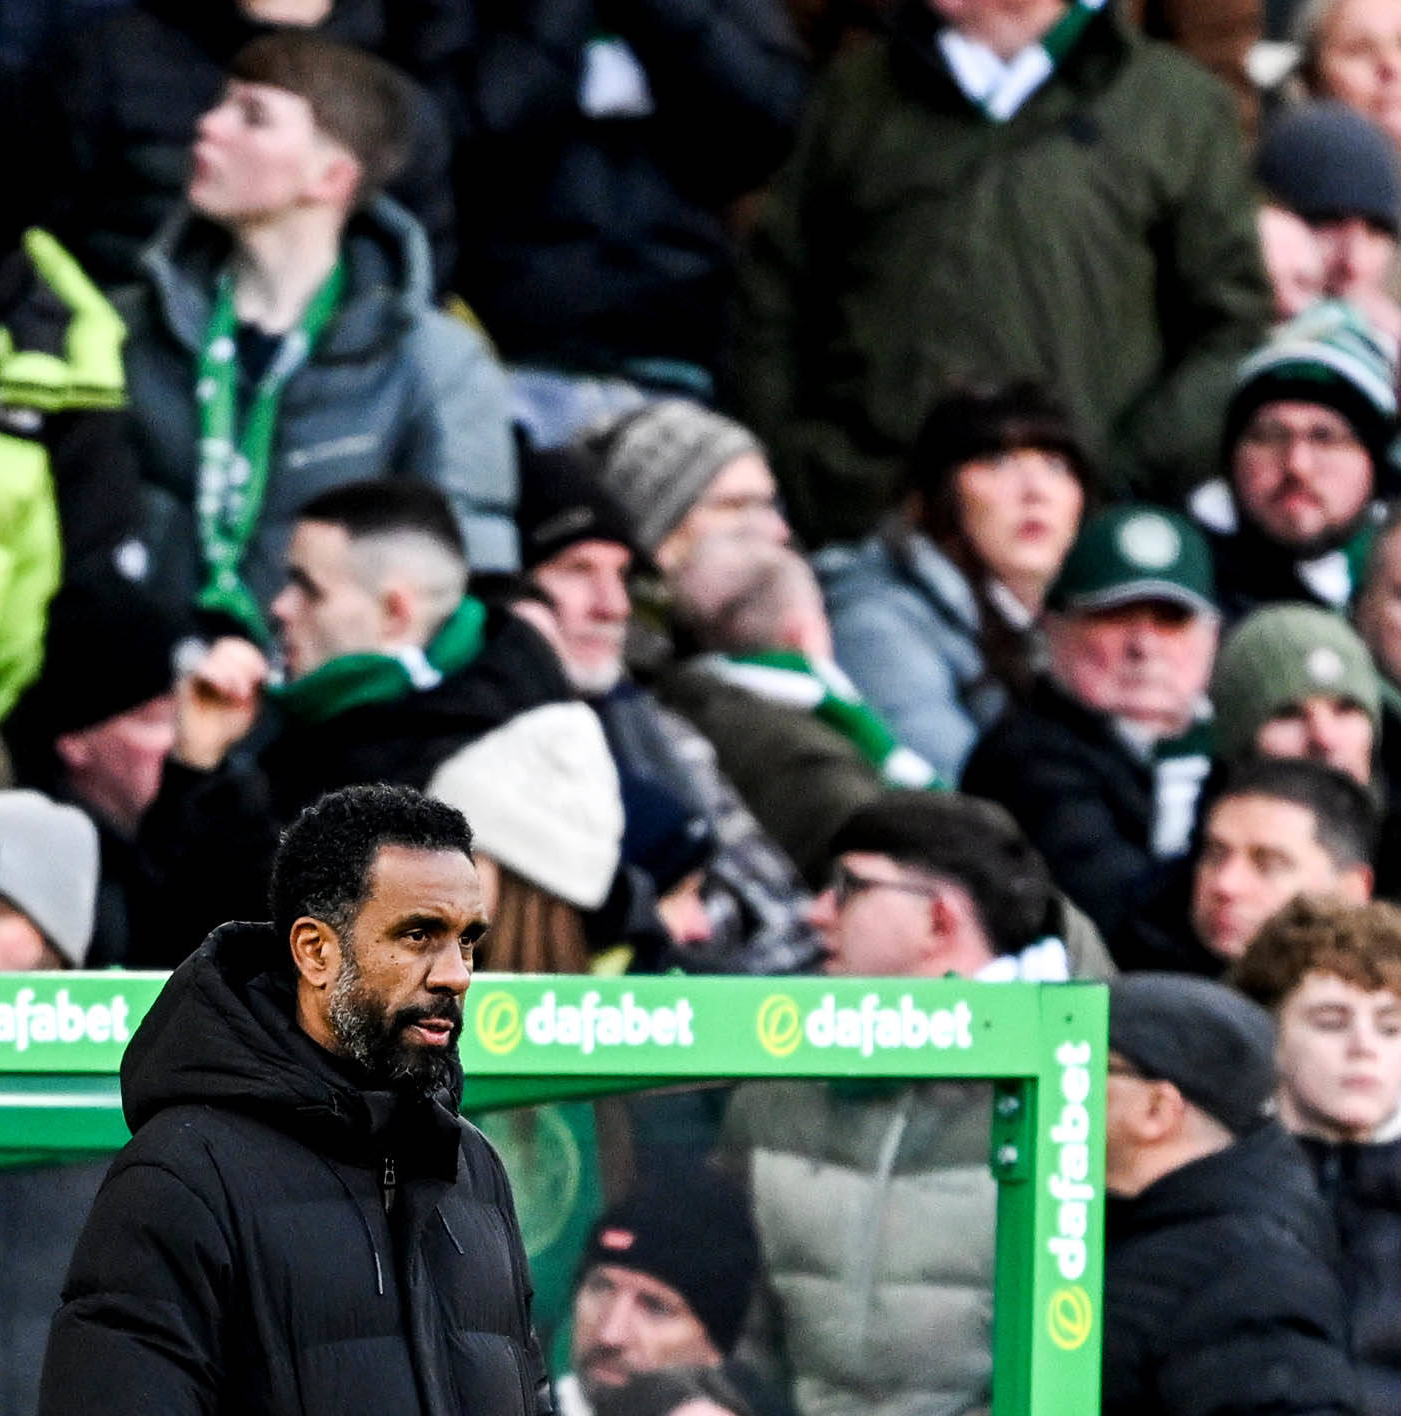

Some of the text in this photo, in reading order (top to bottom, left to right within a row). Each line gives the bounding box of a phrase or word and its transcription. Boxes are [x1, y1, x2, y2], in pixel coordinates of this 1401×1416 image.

[525, 992, 694, 1055] dafabet
[806, 994, 975, 1057] dafabet
[1048, 1041, 1095, 1280] dafabet
